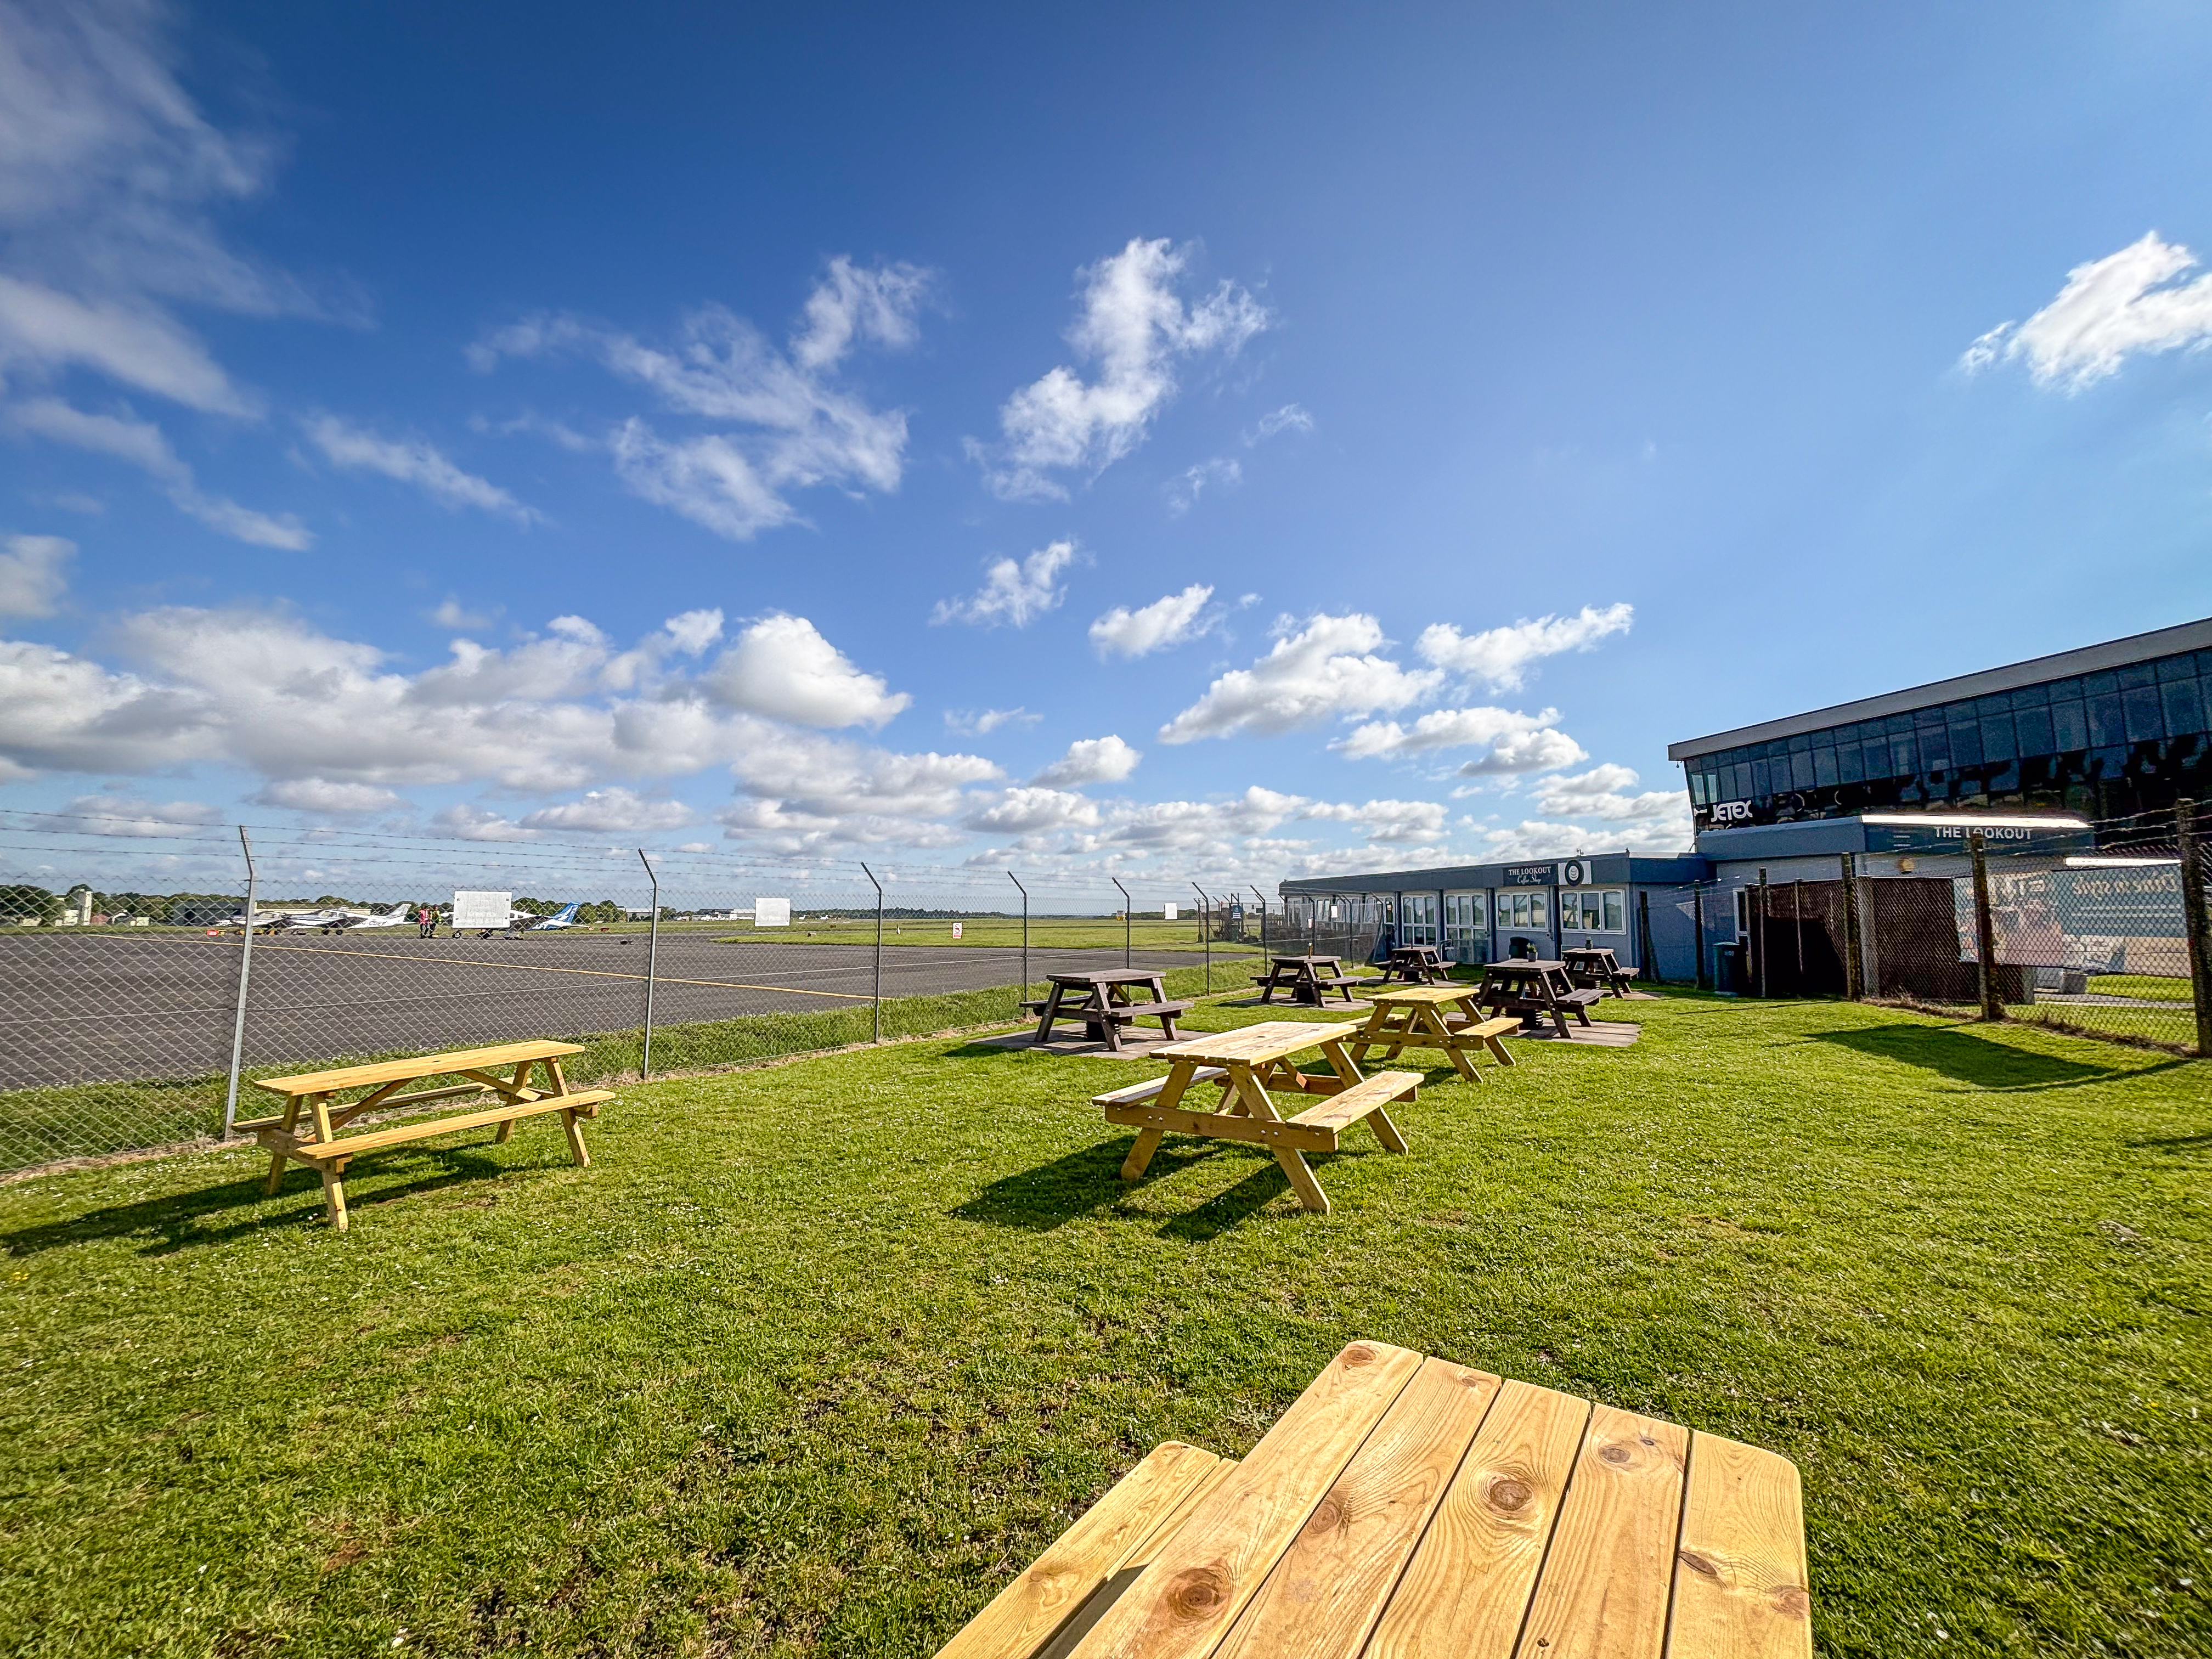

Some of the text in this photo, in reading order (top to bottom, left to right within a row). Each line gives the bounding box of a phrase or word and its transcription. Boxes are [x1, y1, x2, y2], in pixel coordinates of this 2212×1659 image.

[1711, 800, 1753, 822] JETEX
[1933, 826, 1961, 838] THE
[1521, 866, 1551, 876] LOOKOUT
